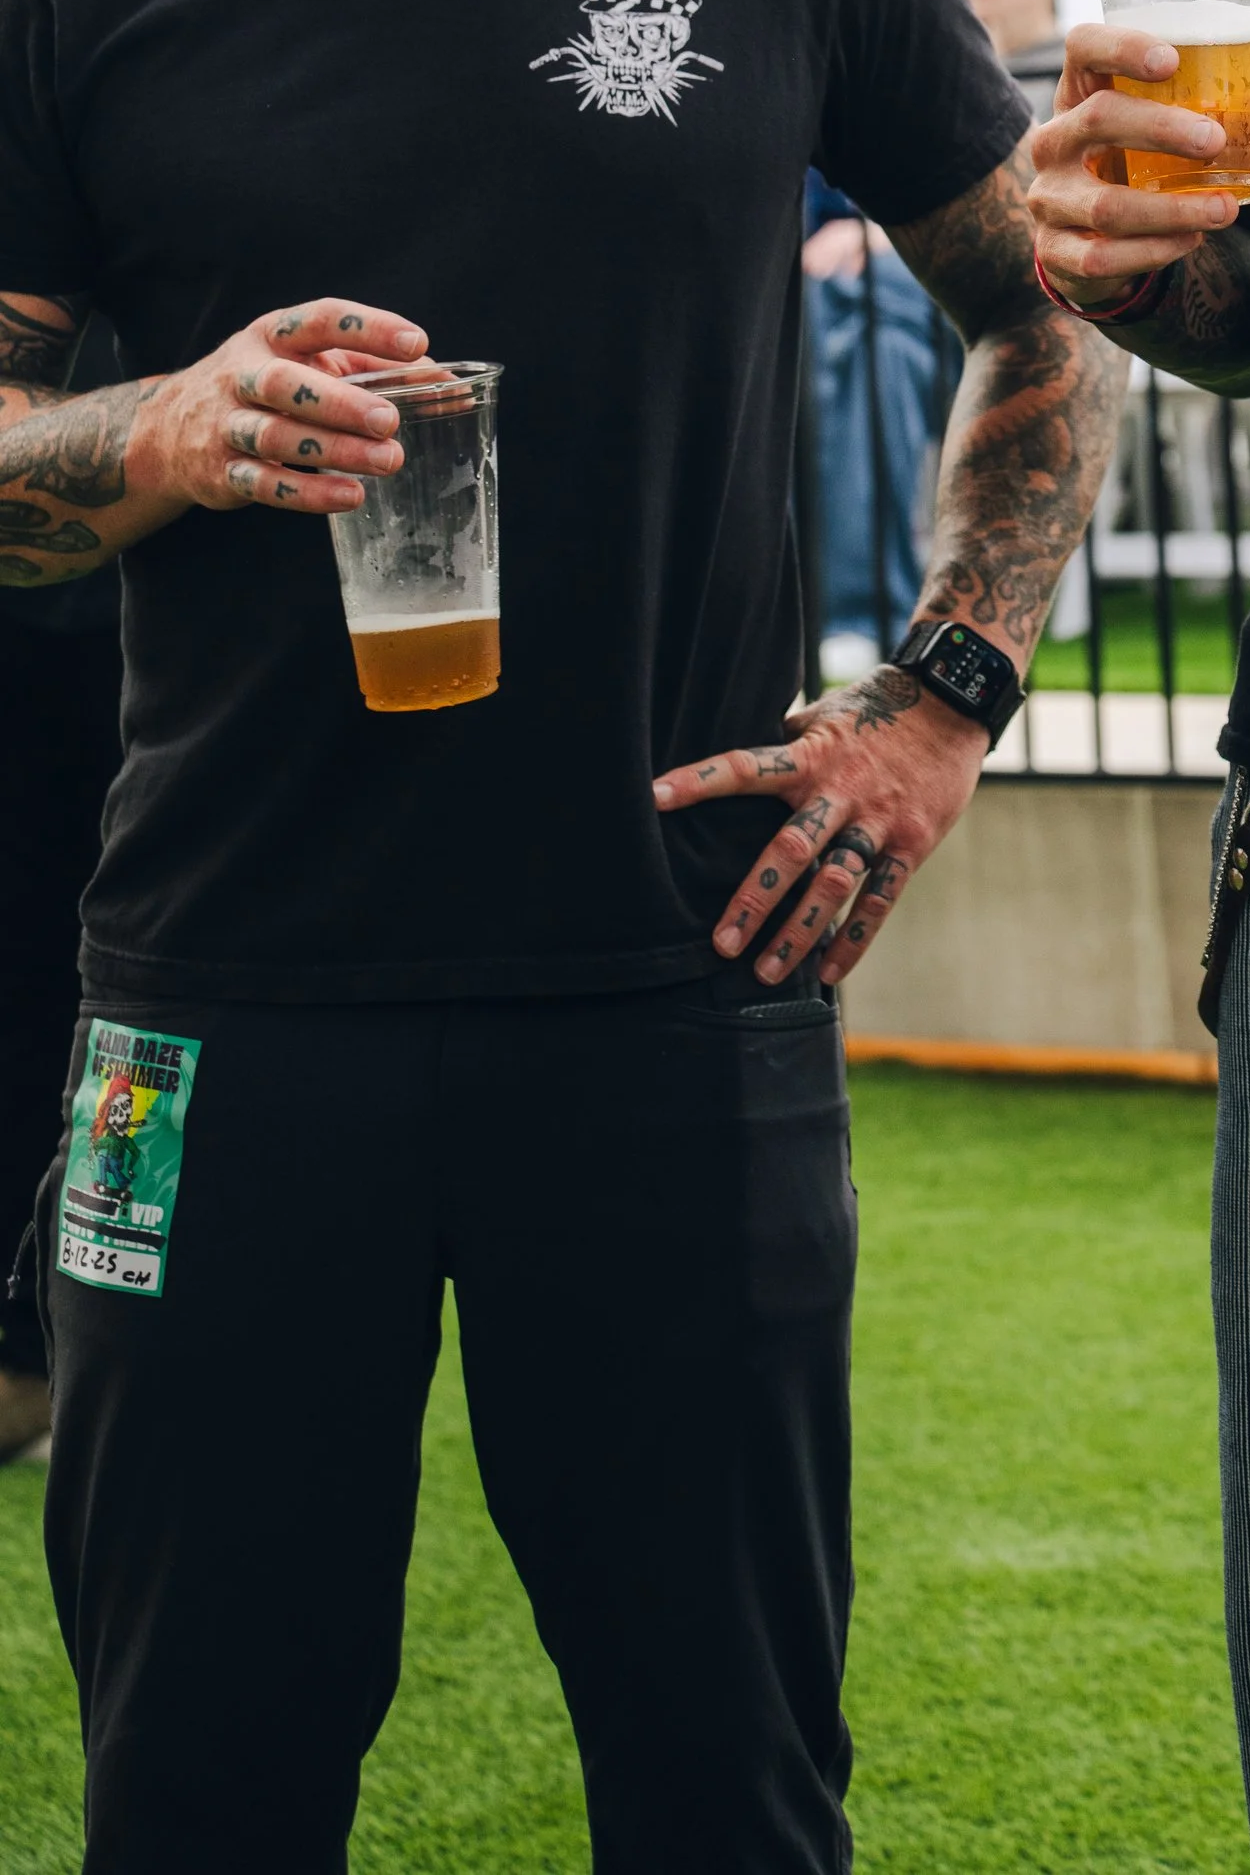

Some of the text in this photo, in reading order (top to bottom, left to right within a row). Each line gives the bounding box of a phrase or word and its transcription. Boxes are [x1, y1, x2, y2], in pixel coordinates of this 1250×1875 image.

[96, 1029, 184, 1069] DANK DAZE
[92, 1053, 181, 1094] OF SUMMER
[131, 1202, 164, 1227] VIP
[122, 1270, 151, 1286] CH
